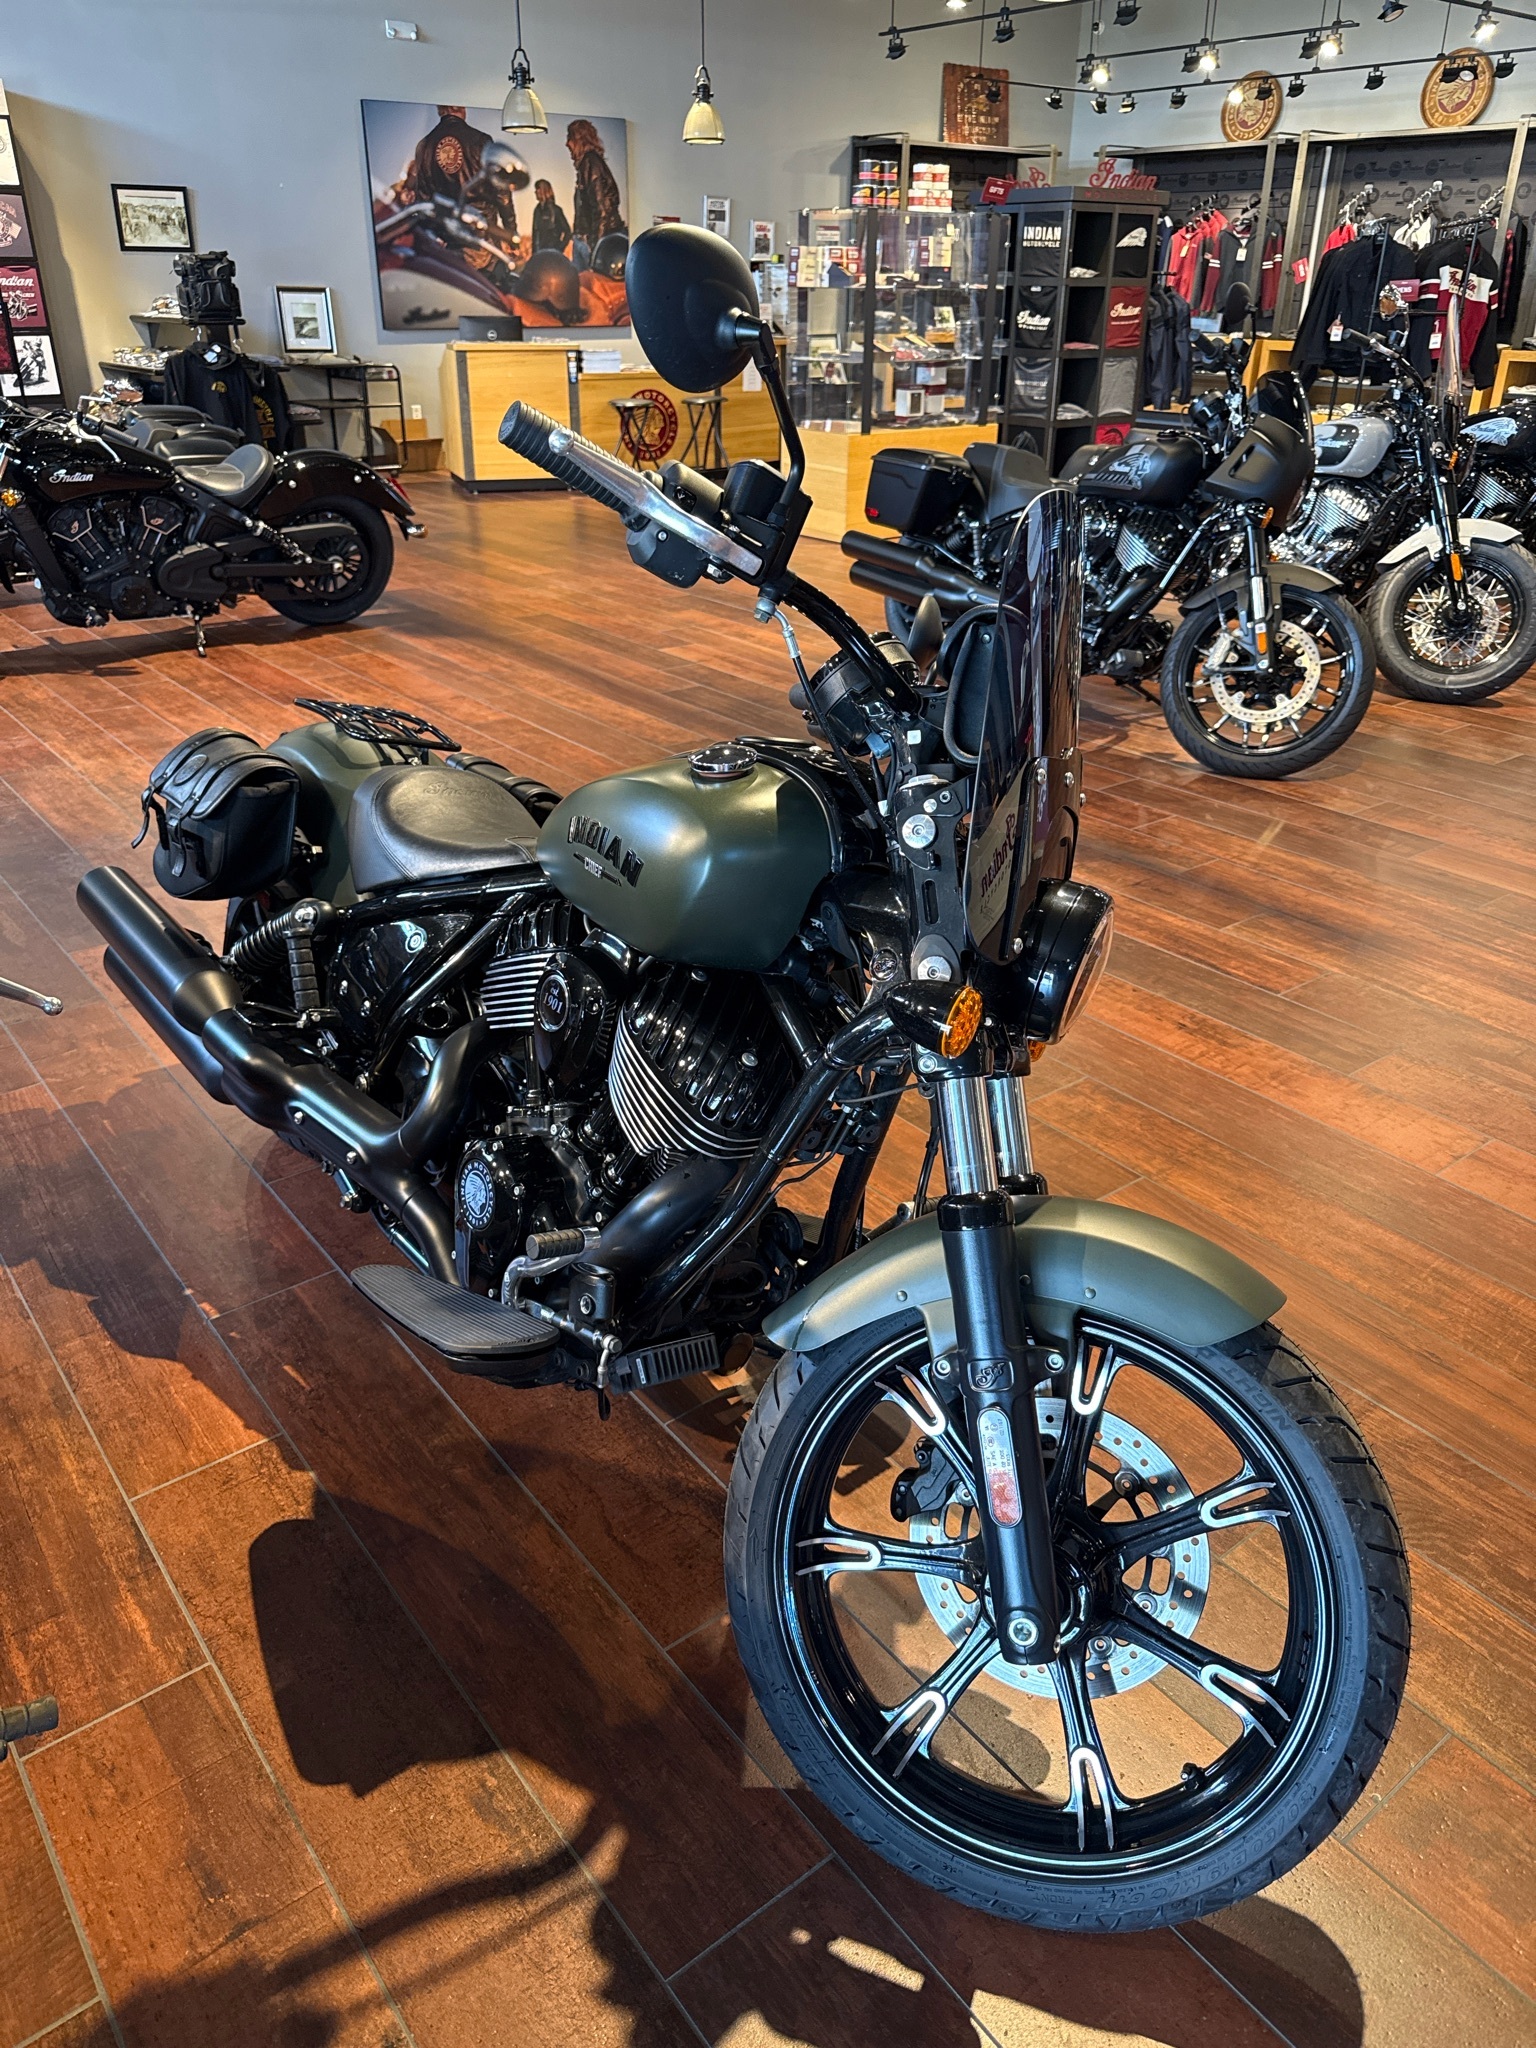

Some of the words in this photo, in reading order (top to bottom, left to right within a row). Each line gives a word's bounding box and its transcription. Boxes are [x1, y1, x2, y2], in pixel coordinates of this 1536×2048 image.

[1089, 158, 1158, 191] Indian
[1023, 226, 1061, 240] INDIAN
[0, 275, 34, 287] ndian
[1017, 310, 1051, 326] Indian
[49, 469, 94, 484] Indian
[567, 815, 644, 888] INDIAN
[584, 856, 602, 879] CHIEF
[543, 992, 563, 1014] 1901
[460, 1162, 473, 1201] INDIAN
[473, 1161, 494, 1225] MOTORCYCLE
[1219, 1366, 1293, 1431] NIGHT
[1250, 1783, 1318, 1851] 130/60
[1206, 1864, 1231, 1882] 19
[1152, 1875, 1203, 1900] M/C
[1032, 1892, 1073, 1906] FRONT
